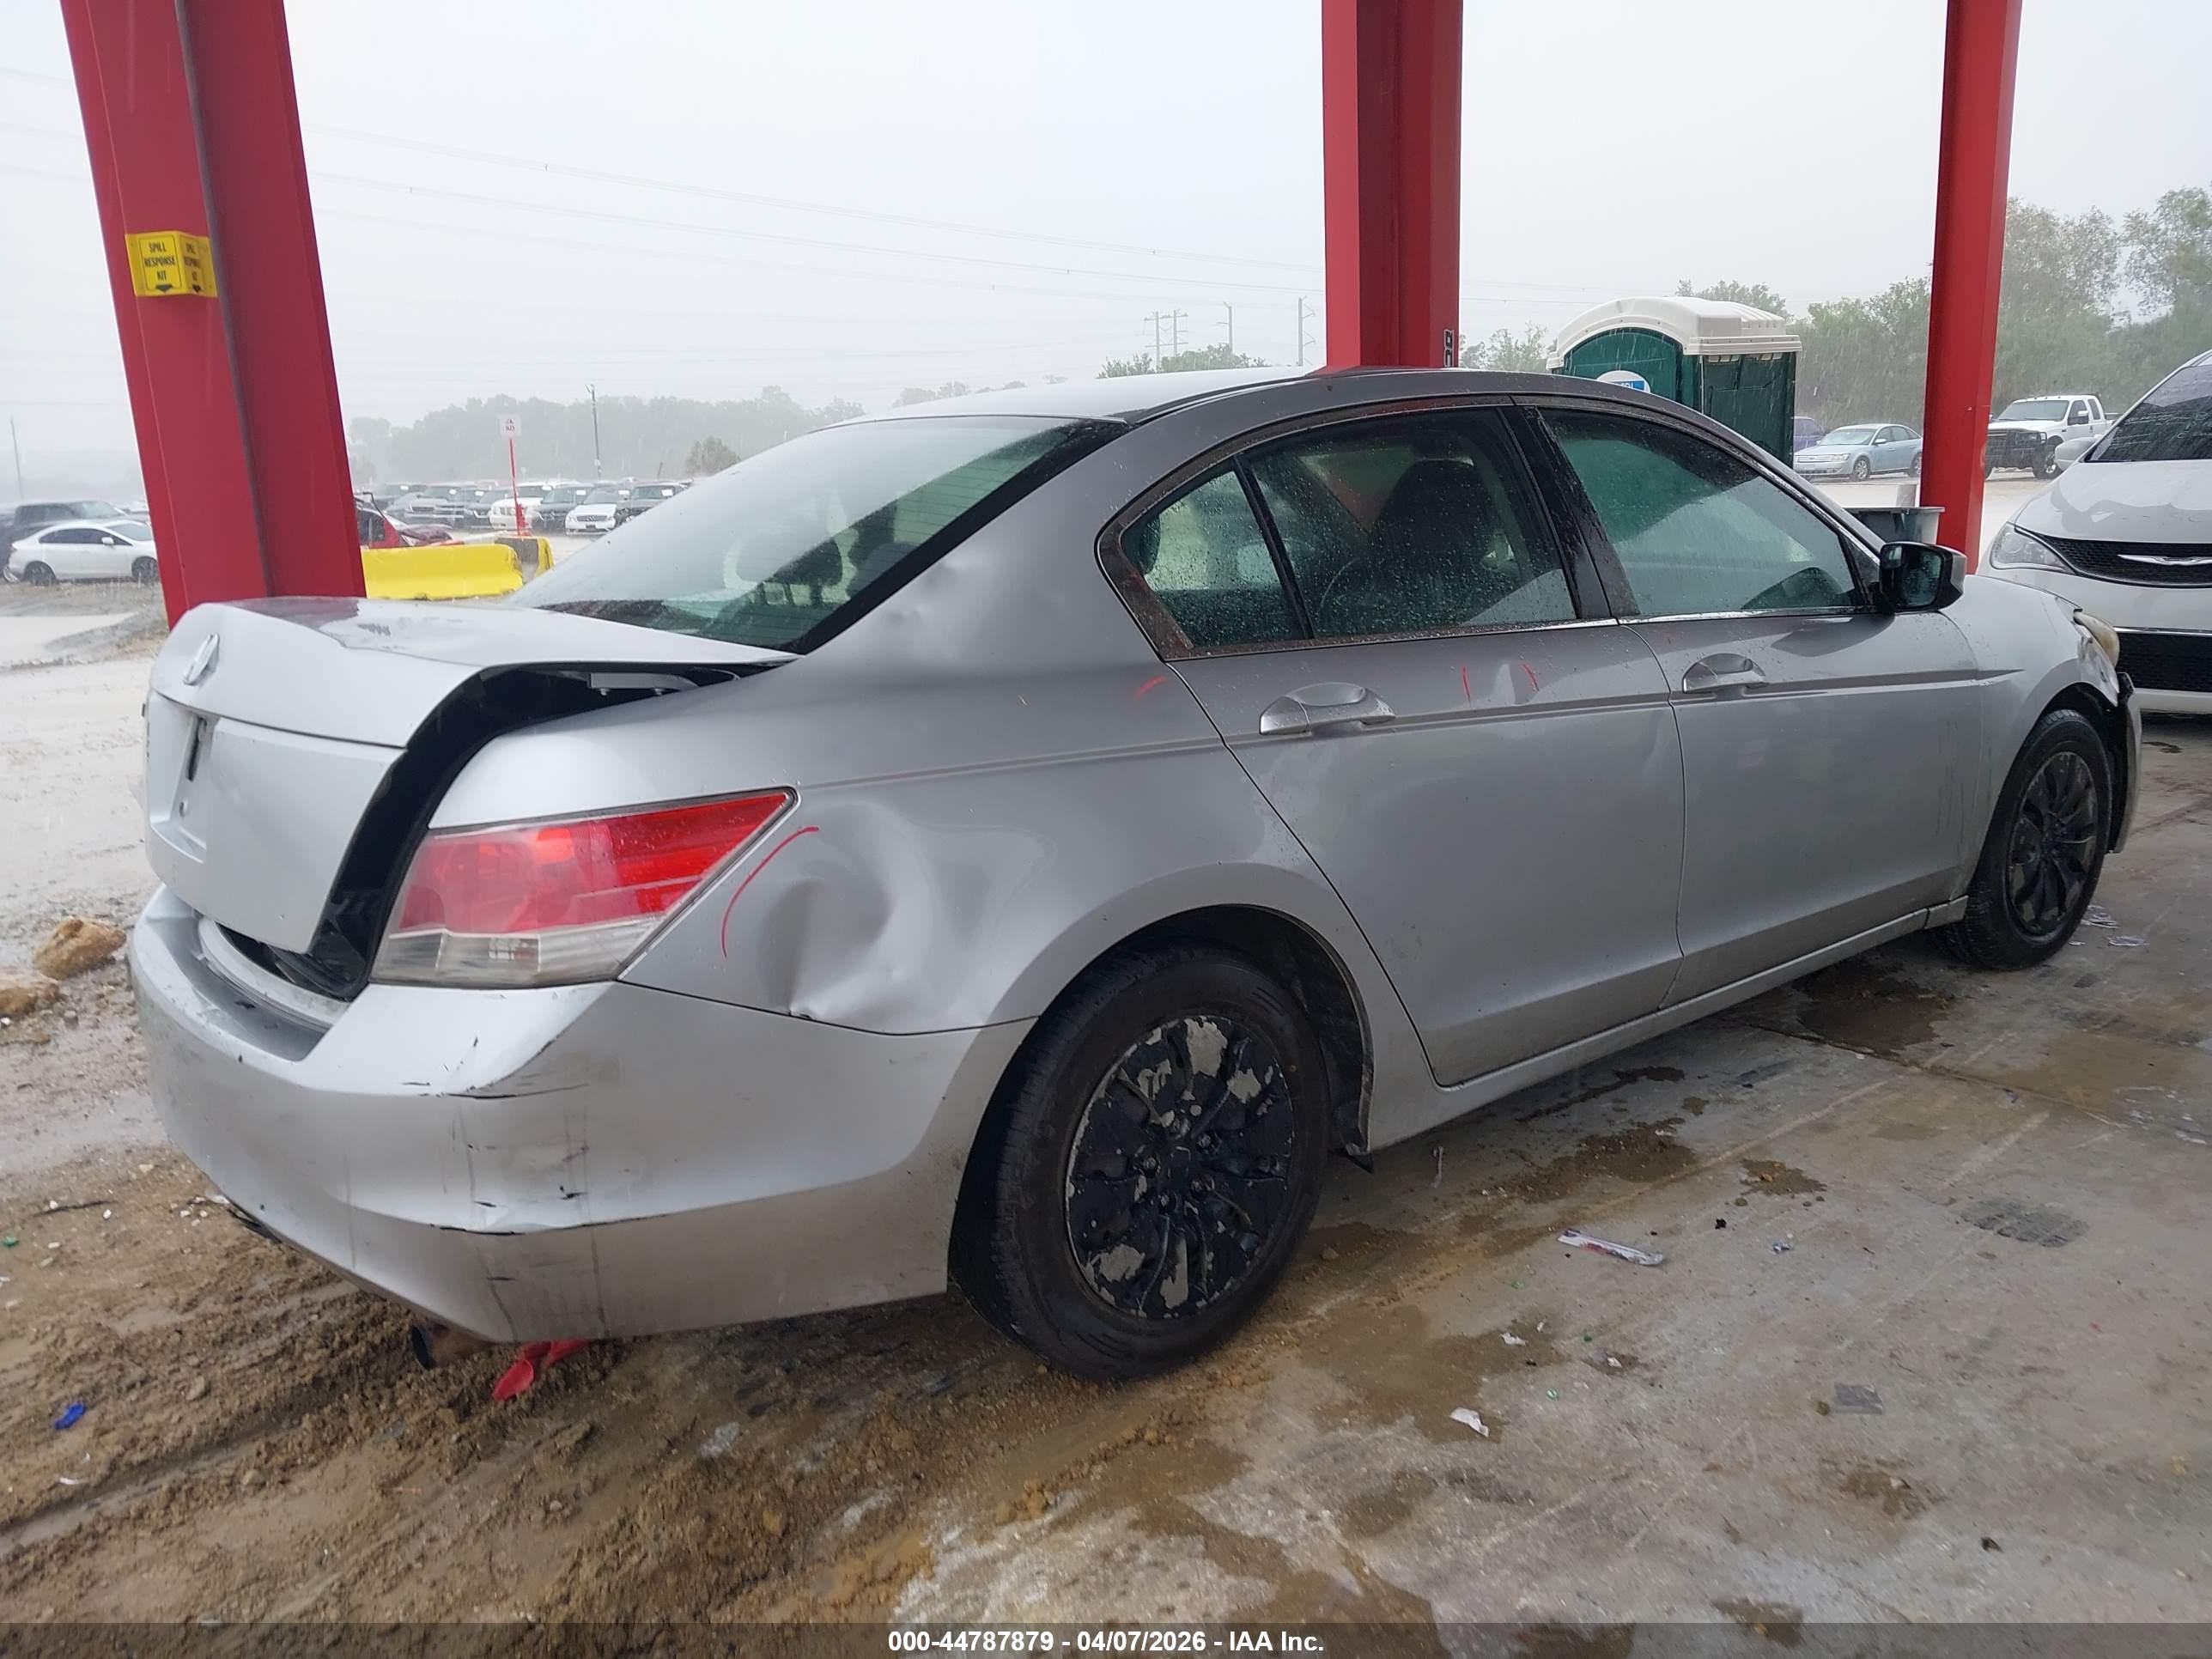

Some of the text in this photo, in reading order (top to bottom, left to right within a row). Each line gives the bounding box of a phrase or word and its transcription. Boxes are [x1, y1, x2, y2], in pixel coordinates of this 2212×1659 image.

[149, 241, 167, 253] SPILL
[143, 256, 176, 268] RESPONSE
[156, 270, 167, 281] KIT
